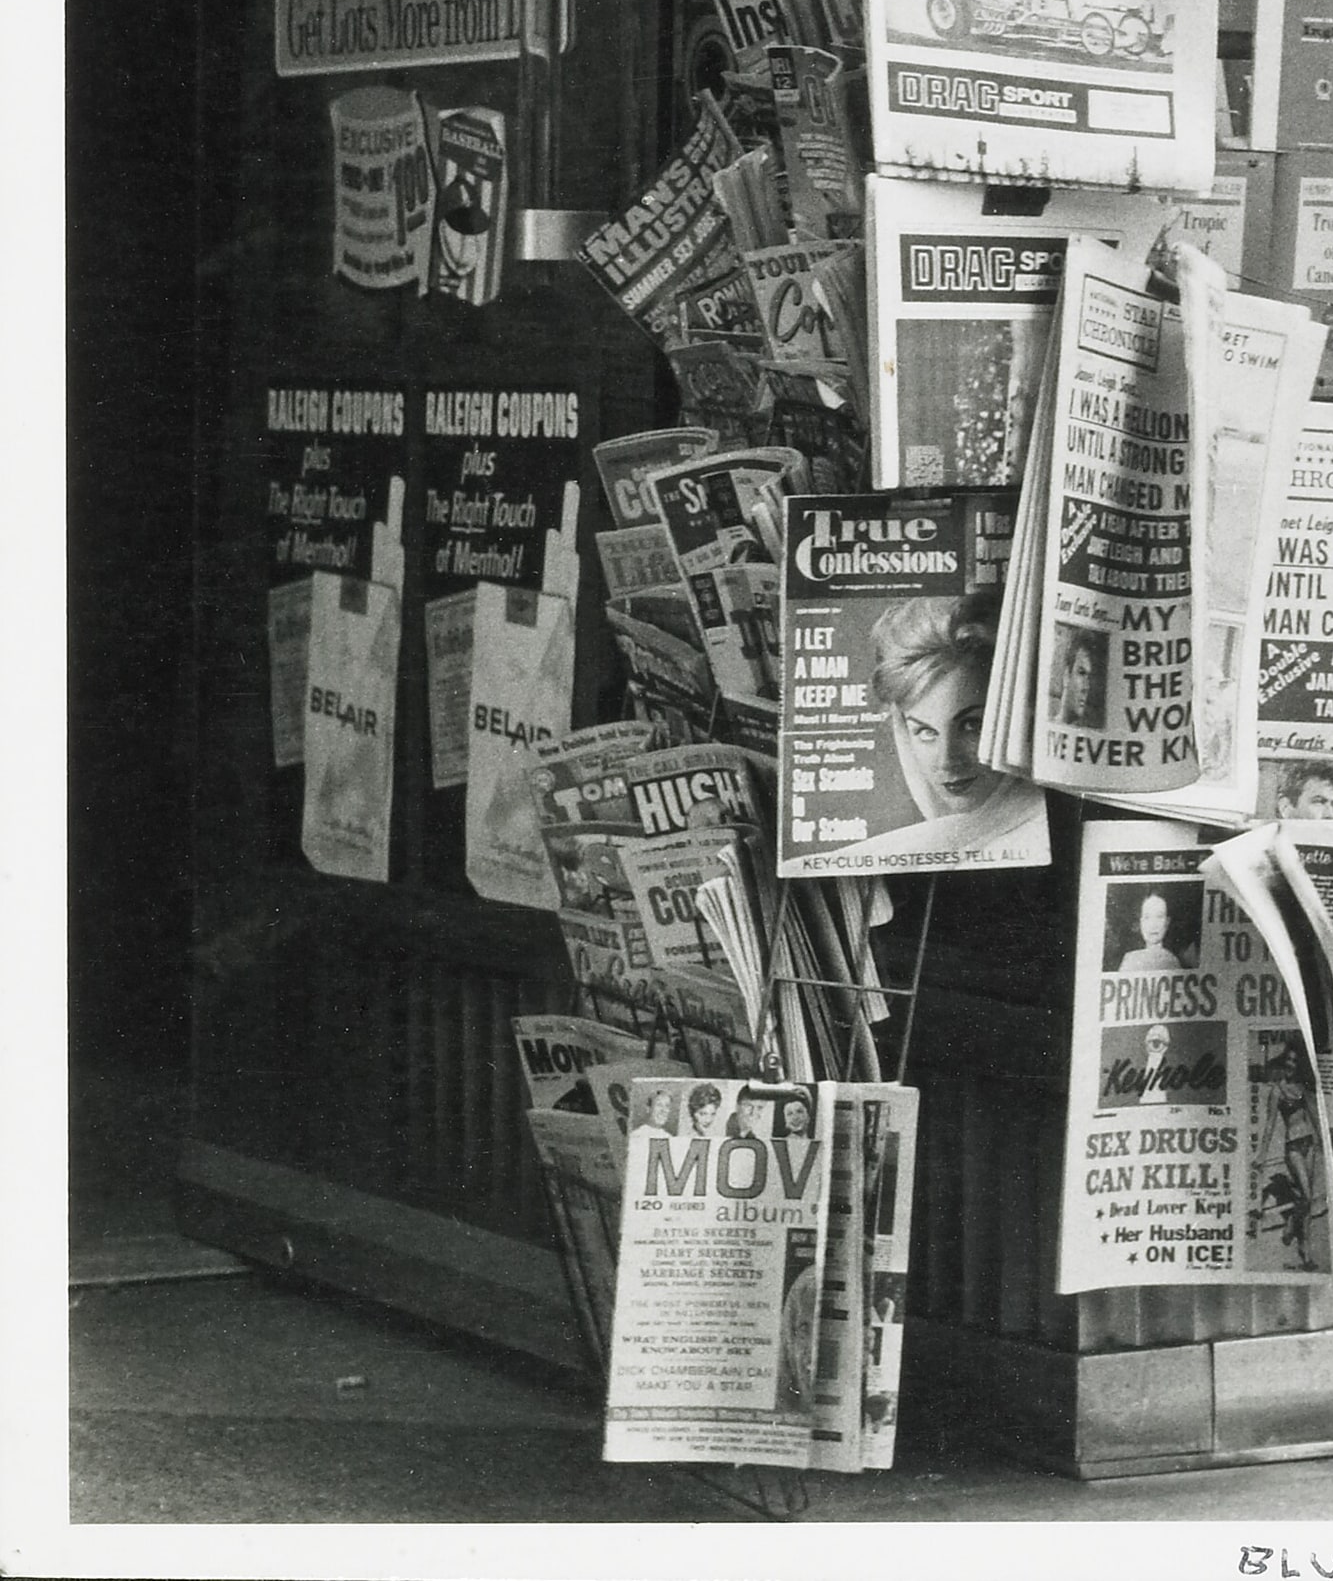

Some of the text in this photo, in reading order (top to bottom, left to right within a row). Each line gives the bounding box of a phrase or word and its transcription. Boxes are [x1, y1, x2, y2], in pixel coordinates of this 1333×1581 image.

[898, 71, 1073, 115] DRAG SPORT
[426, 391, 579, 438] RALEIGH COUPONS
[461, 444, 496, 480] plus
[802, 509, 939, 548] True
[795, 535, 958, 582] Confessions
[1278, 537, 1329, 566] WAS
[805, 627, 835, 649] LET
[795, 656, 849, 678] A MAN
[309, 686, 378, 737] BELAIR
[794, 684, 868, 708] KEEP ME
[803, 856, 873, 870] KEY-CLUB
[879, 852, 959, 867] HOSTESSES
[966, 850, 995, 862] TELL
[1099, 973, 1218, 1021] PRINCESS
[1085, 1127, 1239, 1159] SEX DRUGS
[1085, 1162, 1231, 1195] CAN KILL!
[716, 1201, 803, 1224] album
[1146, 1244, 1233, 1263] ON ICE!
